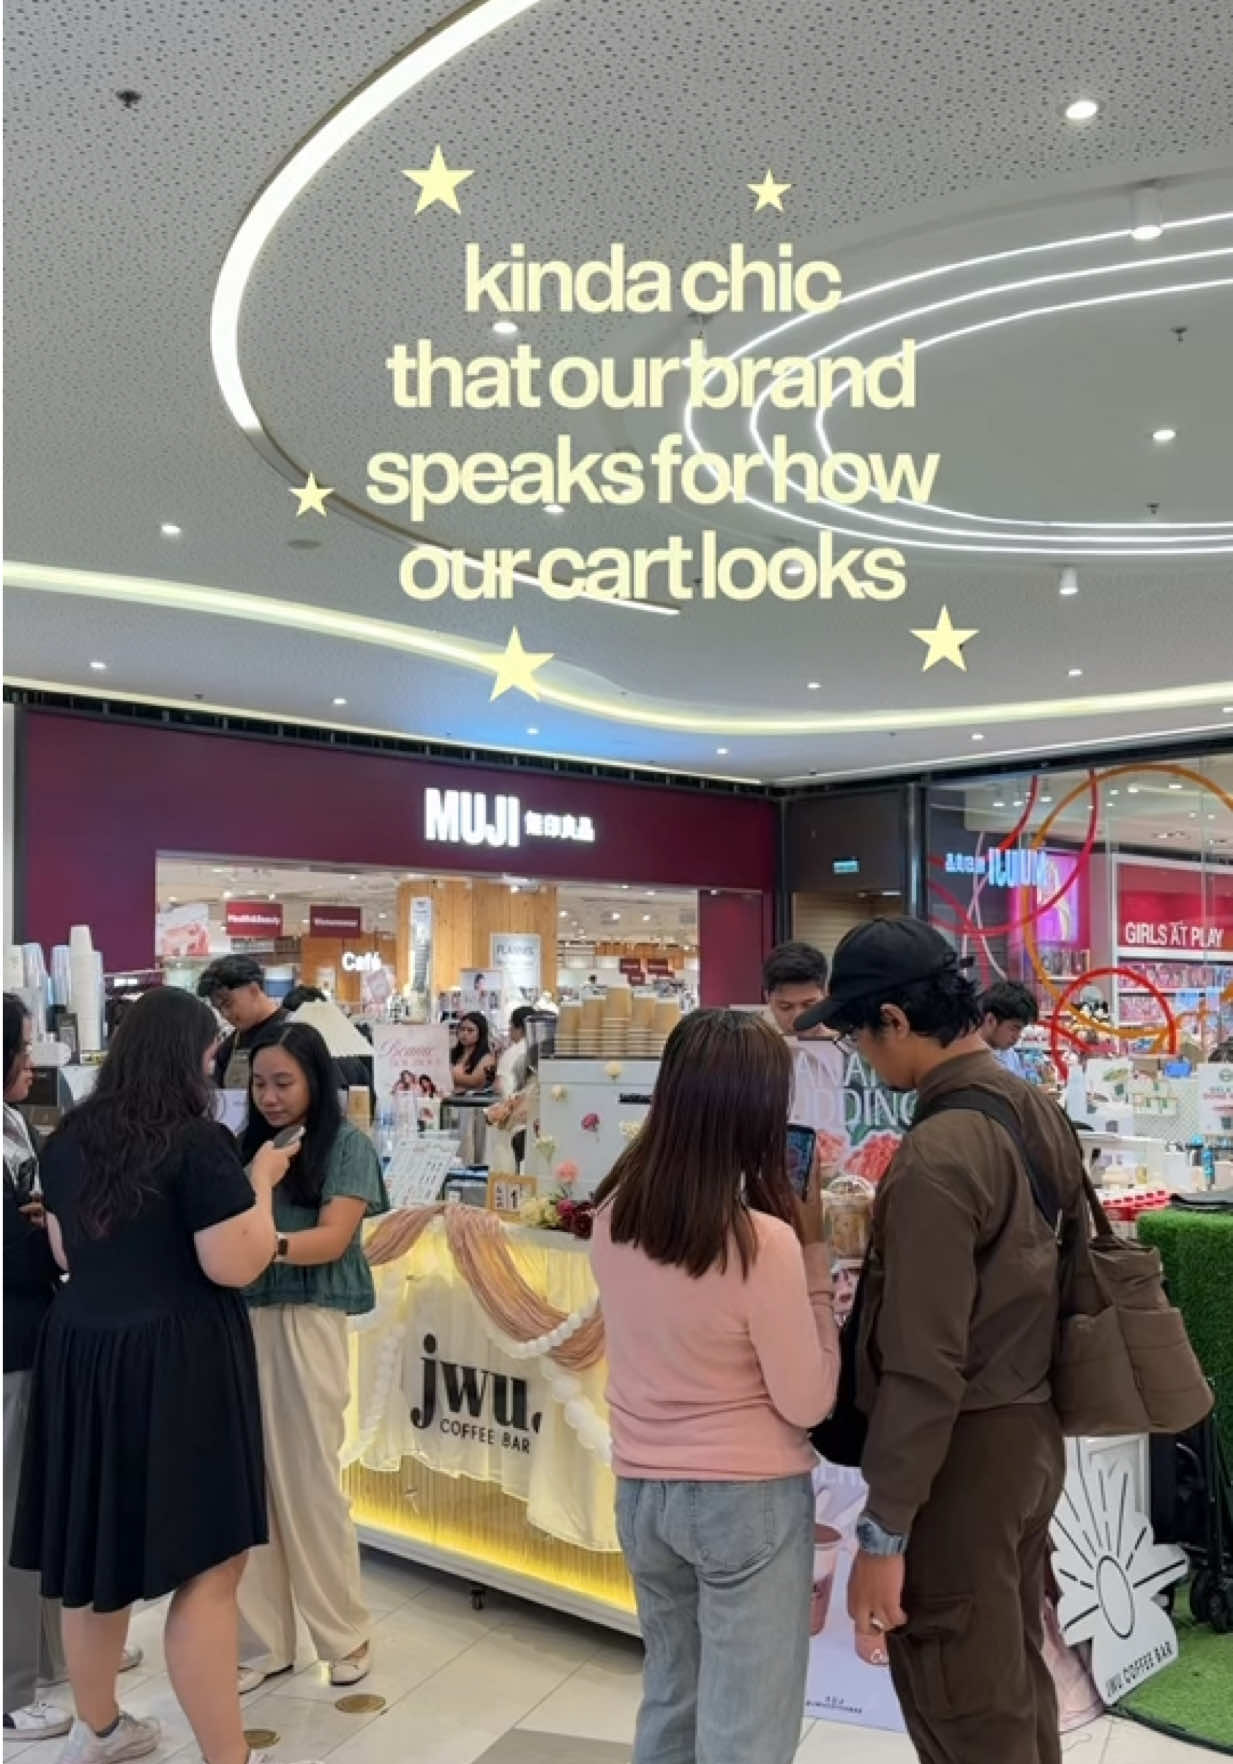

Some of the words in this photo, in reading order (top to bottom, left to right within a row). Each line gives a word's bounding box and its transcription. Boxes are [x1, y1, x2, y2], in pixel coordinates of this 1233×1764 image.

[425, 787, 520, 848] MUJI
[1125, 921, 1168, 946] GIRLS
[1171, 924, 1188, 946] AT
[1191, 926, 1225, 948] PLAY
[440, 1418, 496, 1446] COFFEE
[502, 1431, 530, 1455] BAR
[1122, 1652, 1154, 1684] COFFEE
[1154, 1641, 1173, 1664] BAR
